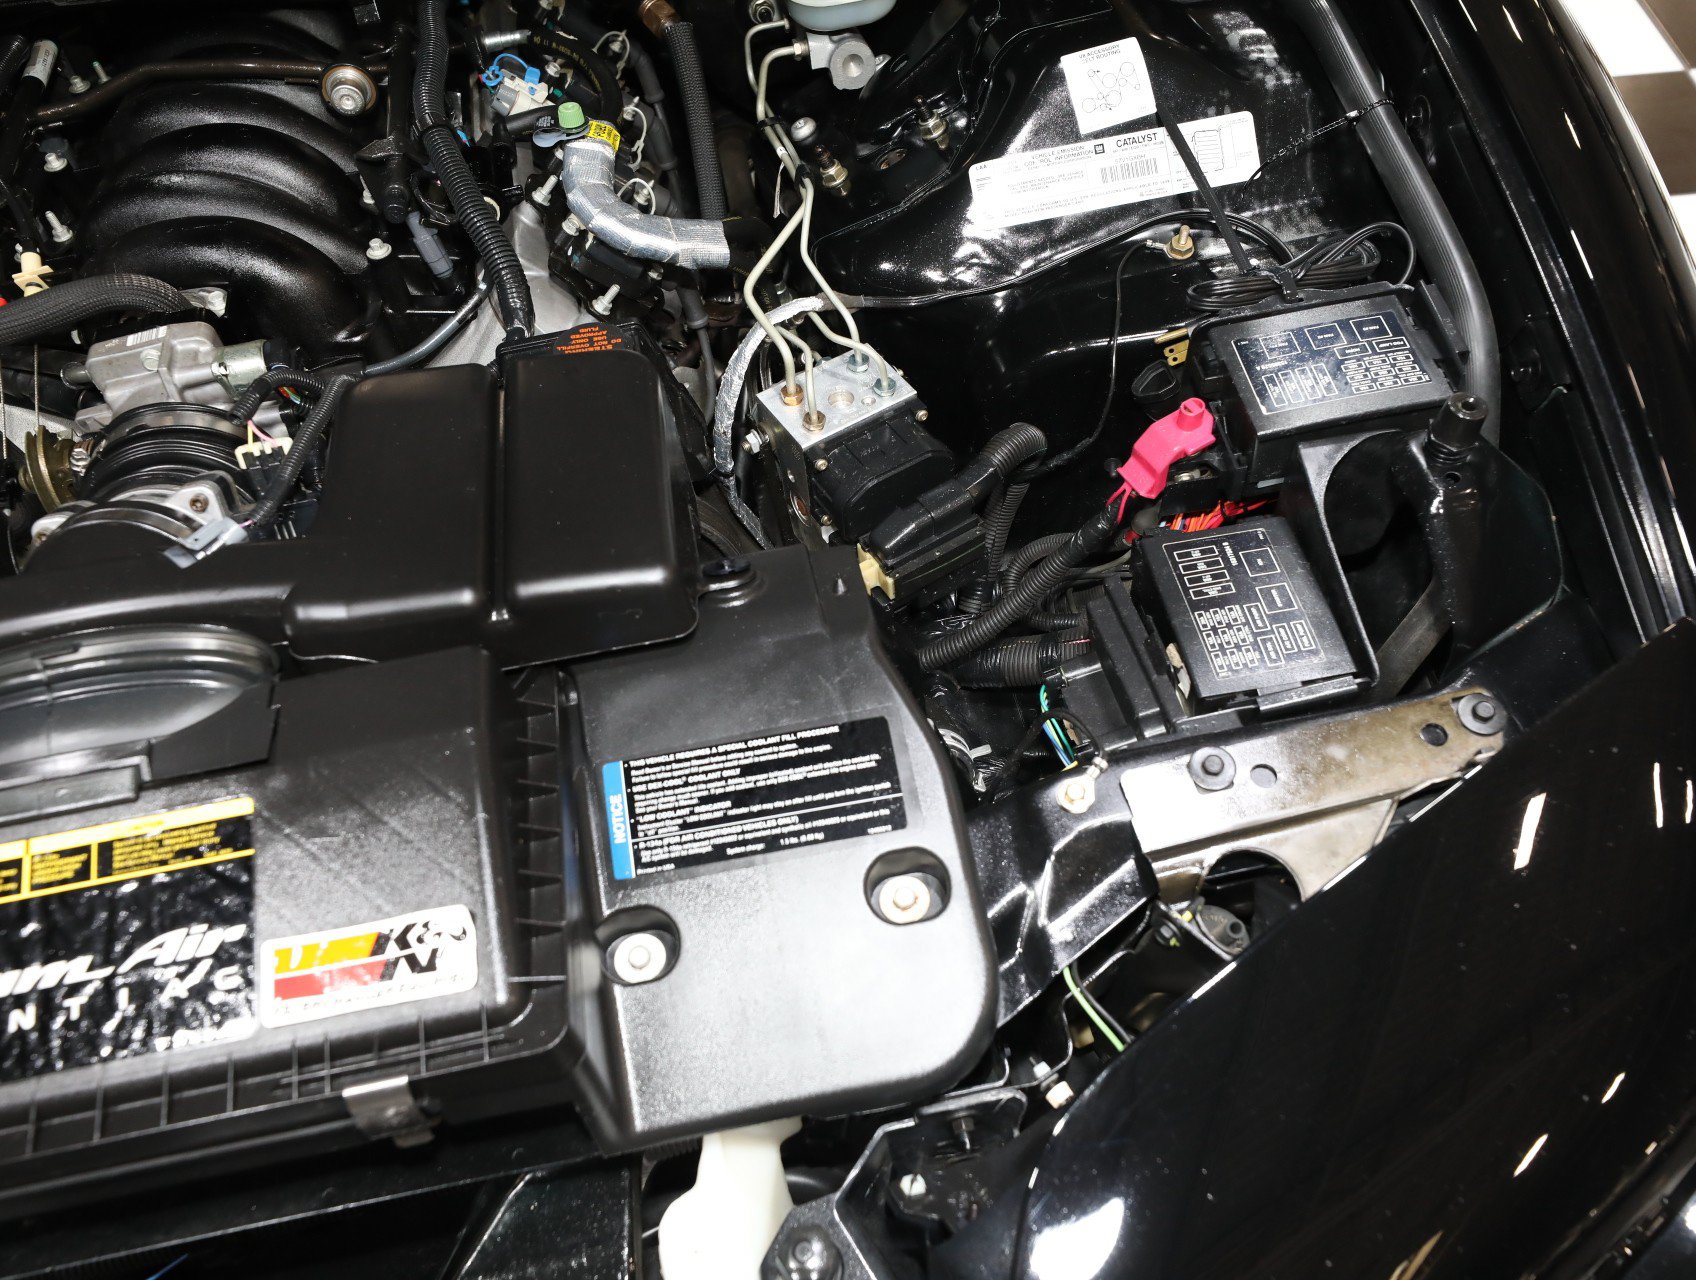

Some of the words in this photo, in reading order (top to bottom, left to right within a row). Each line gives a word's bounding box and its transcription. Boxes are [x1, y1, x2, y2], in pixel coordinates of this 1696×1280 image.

[1087, 44, 1120, 56] ACCESSORY
[1096, 49, 1121, 60] ROUTING
[1116, 132, 1158, 148] CATALYST
[1054, 150, 1094, 161] INFORMATION
[1056, 146, 1085, 157] EMISSION
[570, 330, 608, 339] APPROVED
[556, 343, 590, 351] OVERFILL
[564, 344, 613, 354] STEERING
[1251, 607, 1260, 620] PUMP
[1279, 627, 1288, 641] COMP
[1296, 623, 1306, 636] PUMP
[629, 758, 645, 767] THIS
[645, 753, 674, 764] VEHICLE
[675, 747, 710, 759] REQUIRES
[717, 741, 746, 752] SPECIAL
[746, 735, 780, 747] COOLANT
[780, 733, 795, 741] FILL
[796, 725, 839, 738] PROCEDURE
[630, 768, 644, 776] Read
[644, 765, 665, 774] Owner's
[671, 760, 690, 769] Service
[690, 757, 709, 766] Manual
[710, 754, 726, 763] before
[726, 751, 744, 760] adding
[744, 749, 753, 757] any
[753, 746, 772, 755] coolant
[631, 775, 649, 783] Failure
[656, 771, 671, 779] follow
[698, 762, 723, 772] procedure
[723, 759, 738, 767] could
[738, 757, 753, 765] result
[778, 749, 798, 758] damage
[812, 743, 832, 752] engine.
[631, 783, 647, 793] USE
[687, 770, 721, 783] COOLANT
[721, 767, 740, 777] ONLY
[633, 794, 645, 802] This
[645, 791, 663, 799] vehicle
[674, 785, 697, 794] extended
[706, 780, 726, 789] coolant.
[726, 776, 745, 785] Adding
[745, 772, 768, 782] improper
[794, 765, 813, 773] coolant
[823, 759, 842, 768] shorten
[851, 755, 870, 763] coolant
[658, 795, 676, 804] change
[676, 792, 690, 800] much
[755, 779, 765, 787] use
[766, 777, 777, 785] only
[806, 768, 829, 778] extended
[839, 763, 856, 772] engine
[856, 760, 877, 769] coolant.
[645, 804, 657, 812] your
[657, 801, 678, 810] Owner's
[678, 797, 699, 806] Manual.
[693, 800, 731, 813] INDICATOR
[726, 806, 749, 816] indicator
[762, 801, 773, 810] may
[773, 799, 784, 808] stay
[792, 796, 804, 804] after
[804, 794, 812, 802] fill
[812, 792, 824, 801] until
[834, 789, 845, 797] turn
[845, 787, 854, 795] the
[854, 784, 873, 793] ignition
[610, 794, 626, 844] NOTICE
[640, 850, 651, 858] Use
[651, 848, 663, 856] only
[682, 839, 709, 850] refrigerant
[744, 828, 770, 839] equivalent
[781, 822, 804, 832] synthetic
[846, 810, 873, 821] equivalent
[662, 835, 680, 845] (FOR
[680, 833, 694, 842] AIR
[694, 824, 742, 840] CONDITIONED
[742, 818, 776, 831] VEHICLES
[776, 814, 798, 825] ONLY)
[651, 852, 669, 861] system
[687, 845, 712, 854] damaged.
[725, 845, 745, 855] System
[636, 866, 656, 875] Printed
[116, 924, 246, 974] Air
